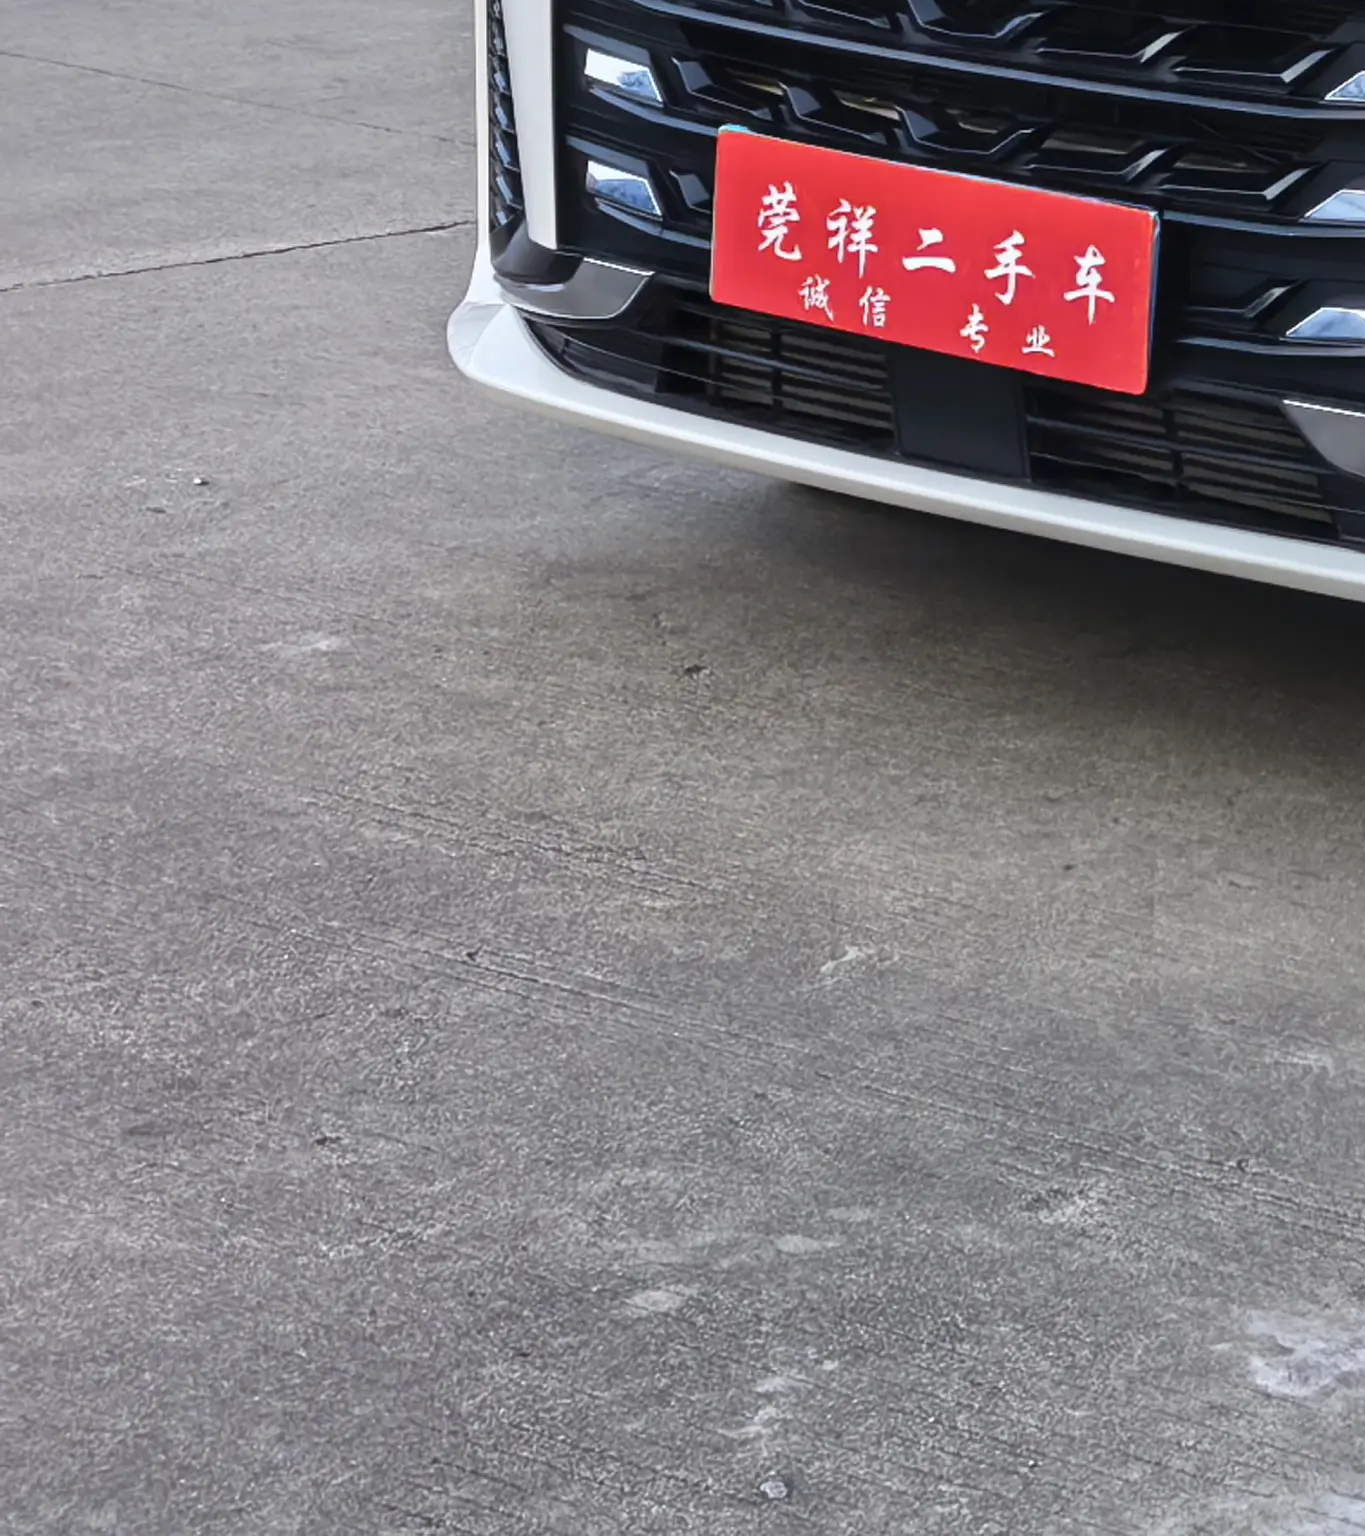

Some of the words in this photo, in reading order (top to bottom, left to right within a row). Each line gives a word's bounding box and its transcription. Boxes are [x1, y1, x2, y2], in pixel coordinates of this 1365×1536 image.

[757, 181, 1116, 325] 莞祥二手车
[799, 275, 891, 328] 诚信
[960, 304, 1055, 358] 专业
